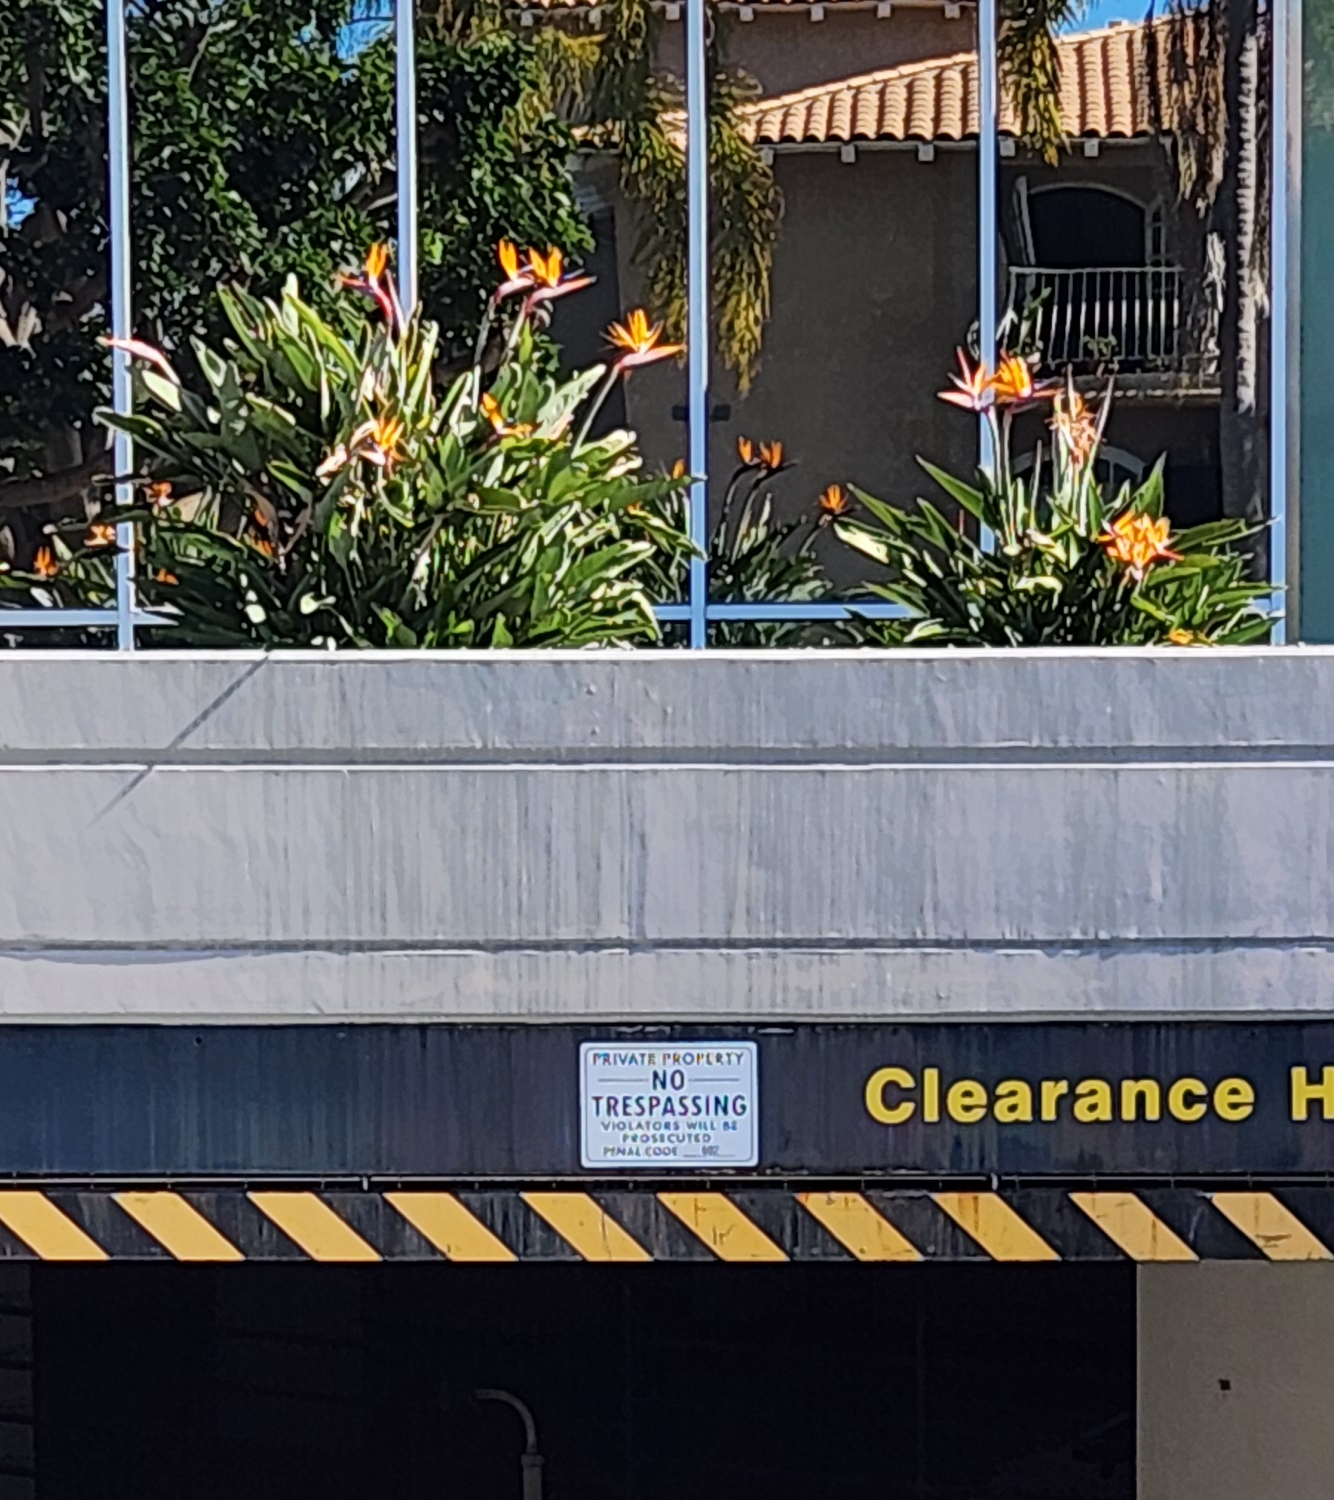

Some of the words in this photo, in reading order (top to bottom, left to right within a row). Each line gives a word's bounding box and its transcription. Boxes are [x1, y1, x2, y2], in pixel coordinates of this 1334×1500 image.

[593, 1053, 656, 1065] PRIVATE
[663, 1052, 744, 1065] PROPERTY
[653, 1069, 684, 1091] NO
[866, 1068, 1254, 1124] Clearance
[592, 1095, 747, 1117] TRESPASSING
[601, 1121, 679, 1131] VIOLATORS
[687, 1121, 716, 1131] WILL
[723, 1121, 737, 1131] BE
[623, 1134, 711, 1143] PROSECUTED
[603, 1147, 640, 1156] PENAL
[645, 1147, 678, 1156] CODE
